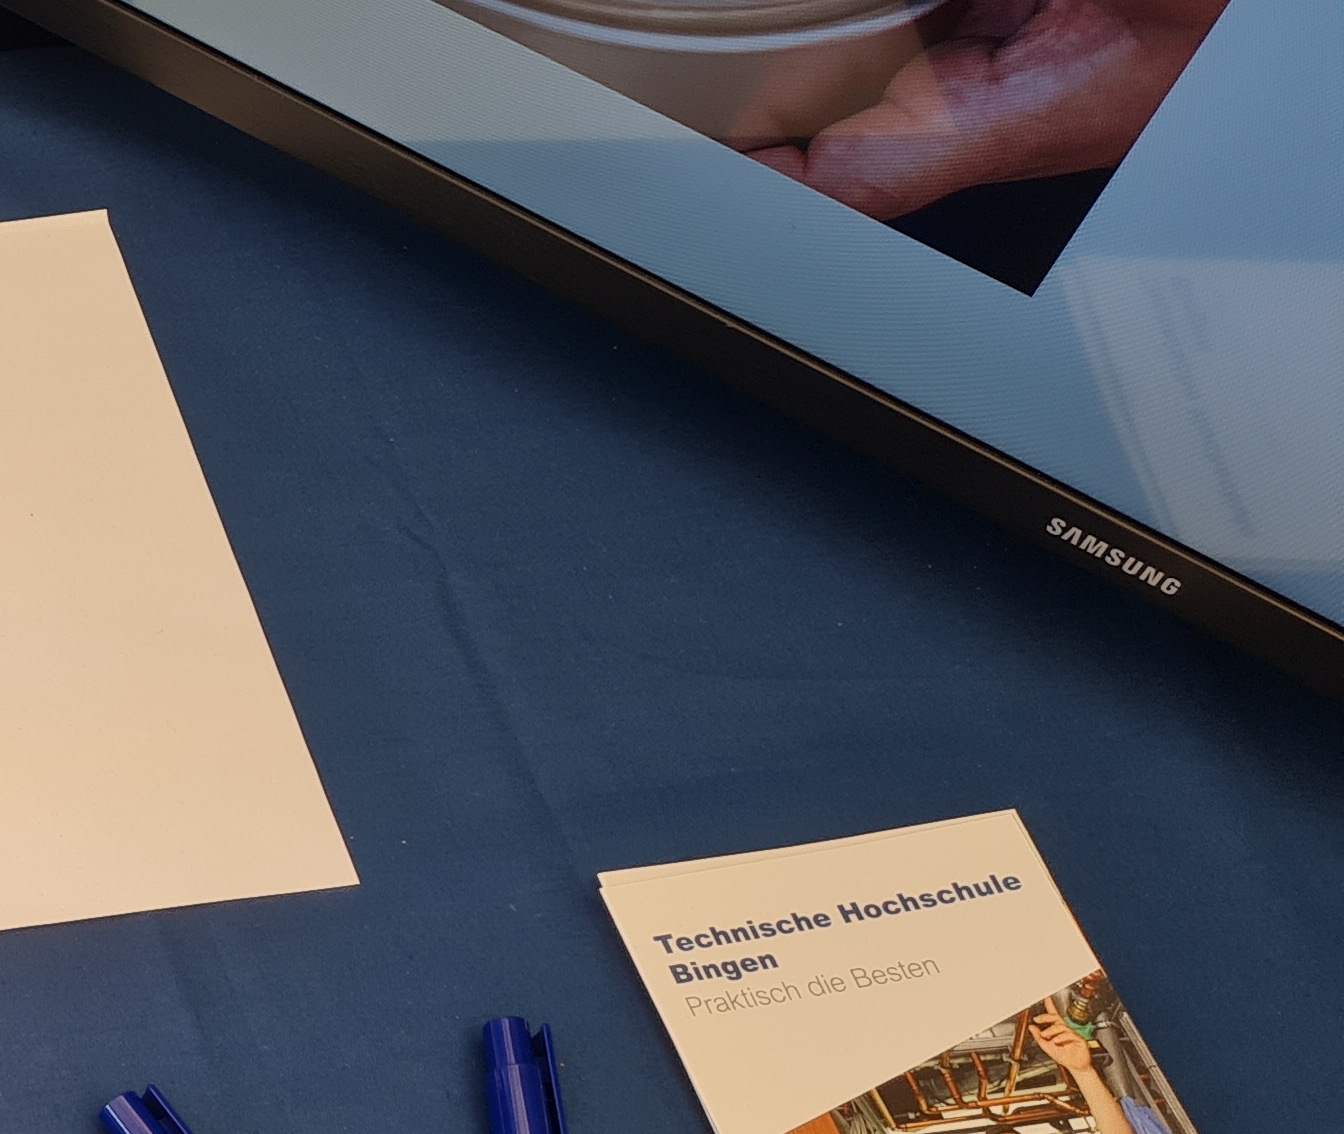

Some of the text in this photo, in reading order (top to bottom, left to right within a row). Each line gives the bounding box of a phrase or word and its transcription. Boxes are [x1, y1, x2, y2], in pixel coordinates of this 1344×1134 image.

[1046, 516, 1182, 596] SAMSUNG
[652, 873, 1023, 955] Technische Hochschule
[668, 953, 780, 985] Bingen
[685, 956, 941, 1018] Praktisch die Besten
